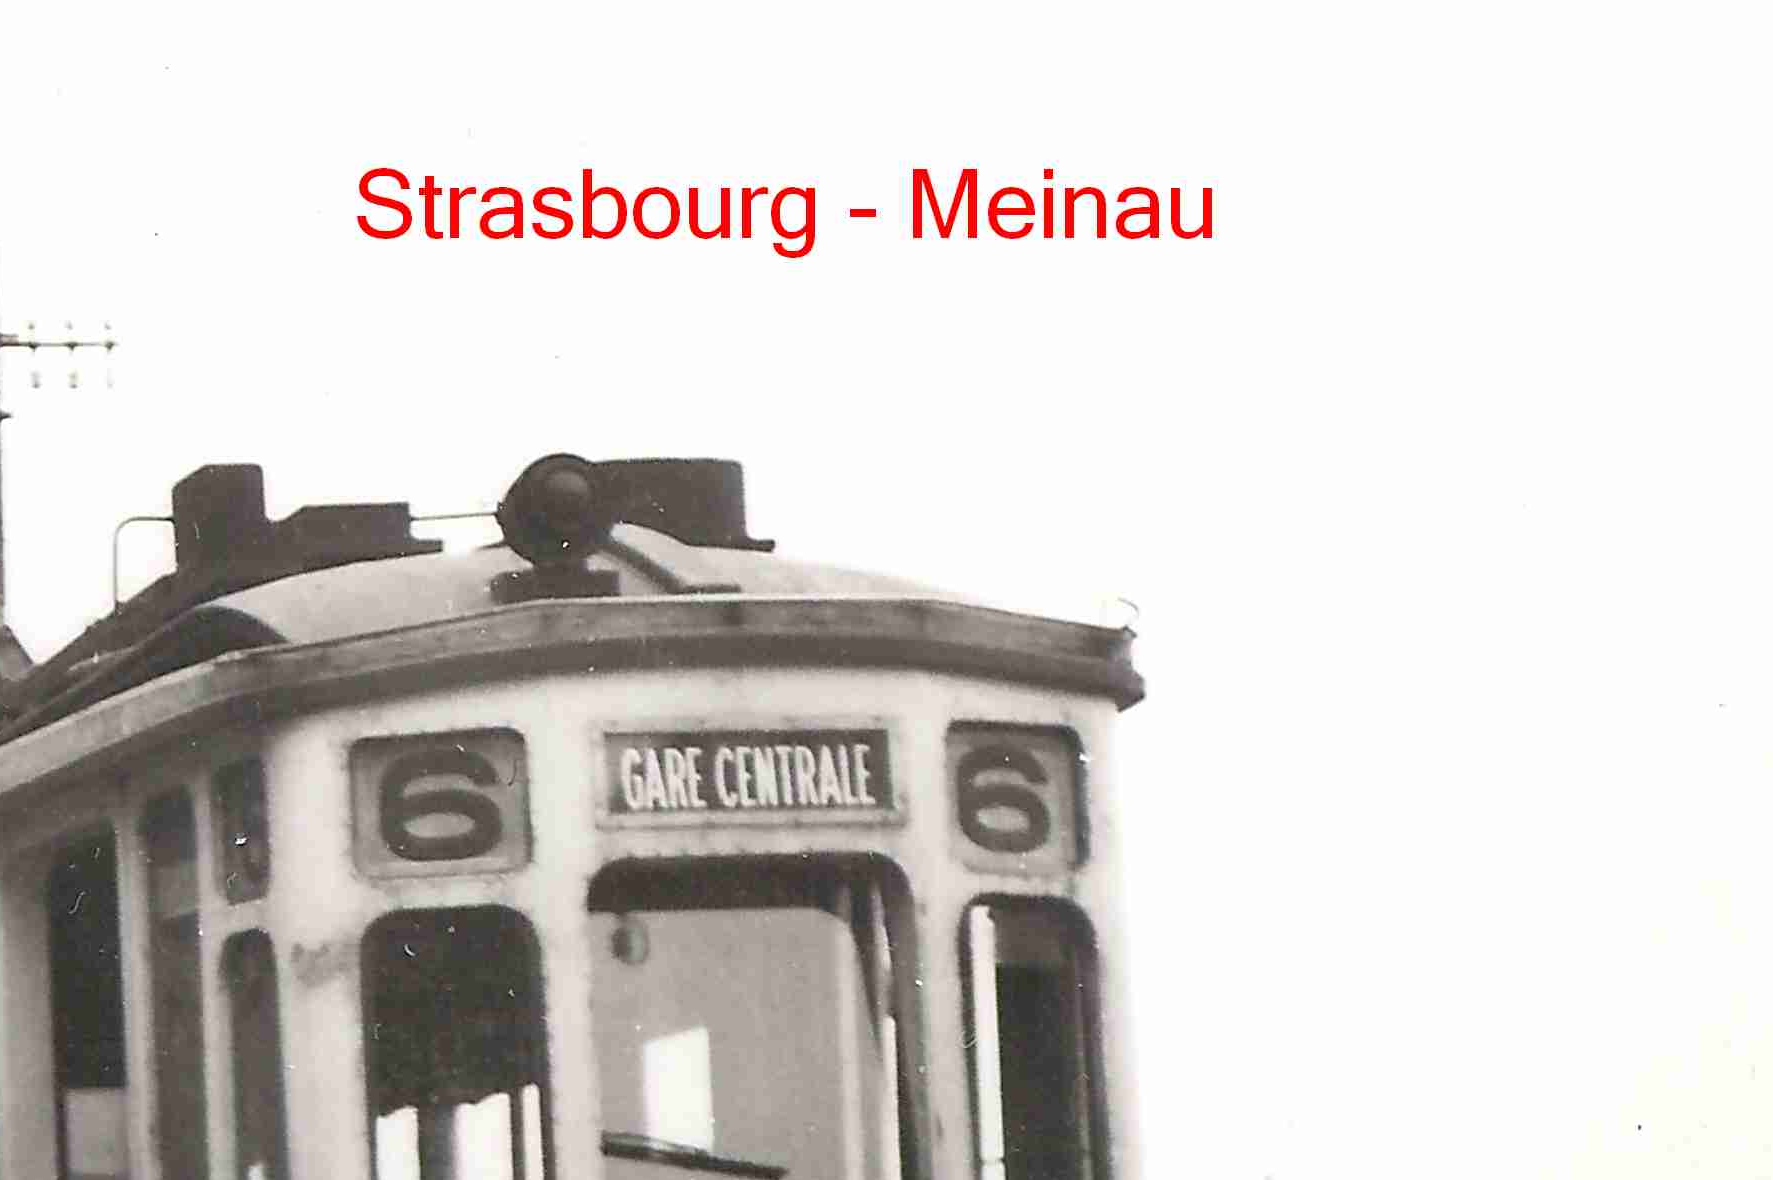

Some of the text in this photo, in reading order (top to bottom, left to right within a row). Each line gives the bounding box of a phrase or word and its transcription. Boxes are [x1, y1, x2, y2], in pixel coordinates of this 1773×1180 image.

[379, 748, 502, 862] 6
[620, 742, 877, 811] GARE CENTRALE
[956, 743, 1051, 854] 6
